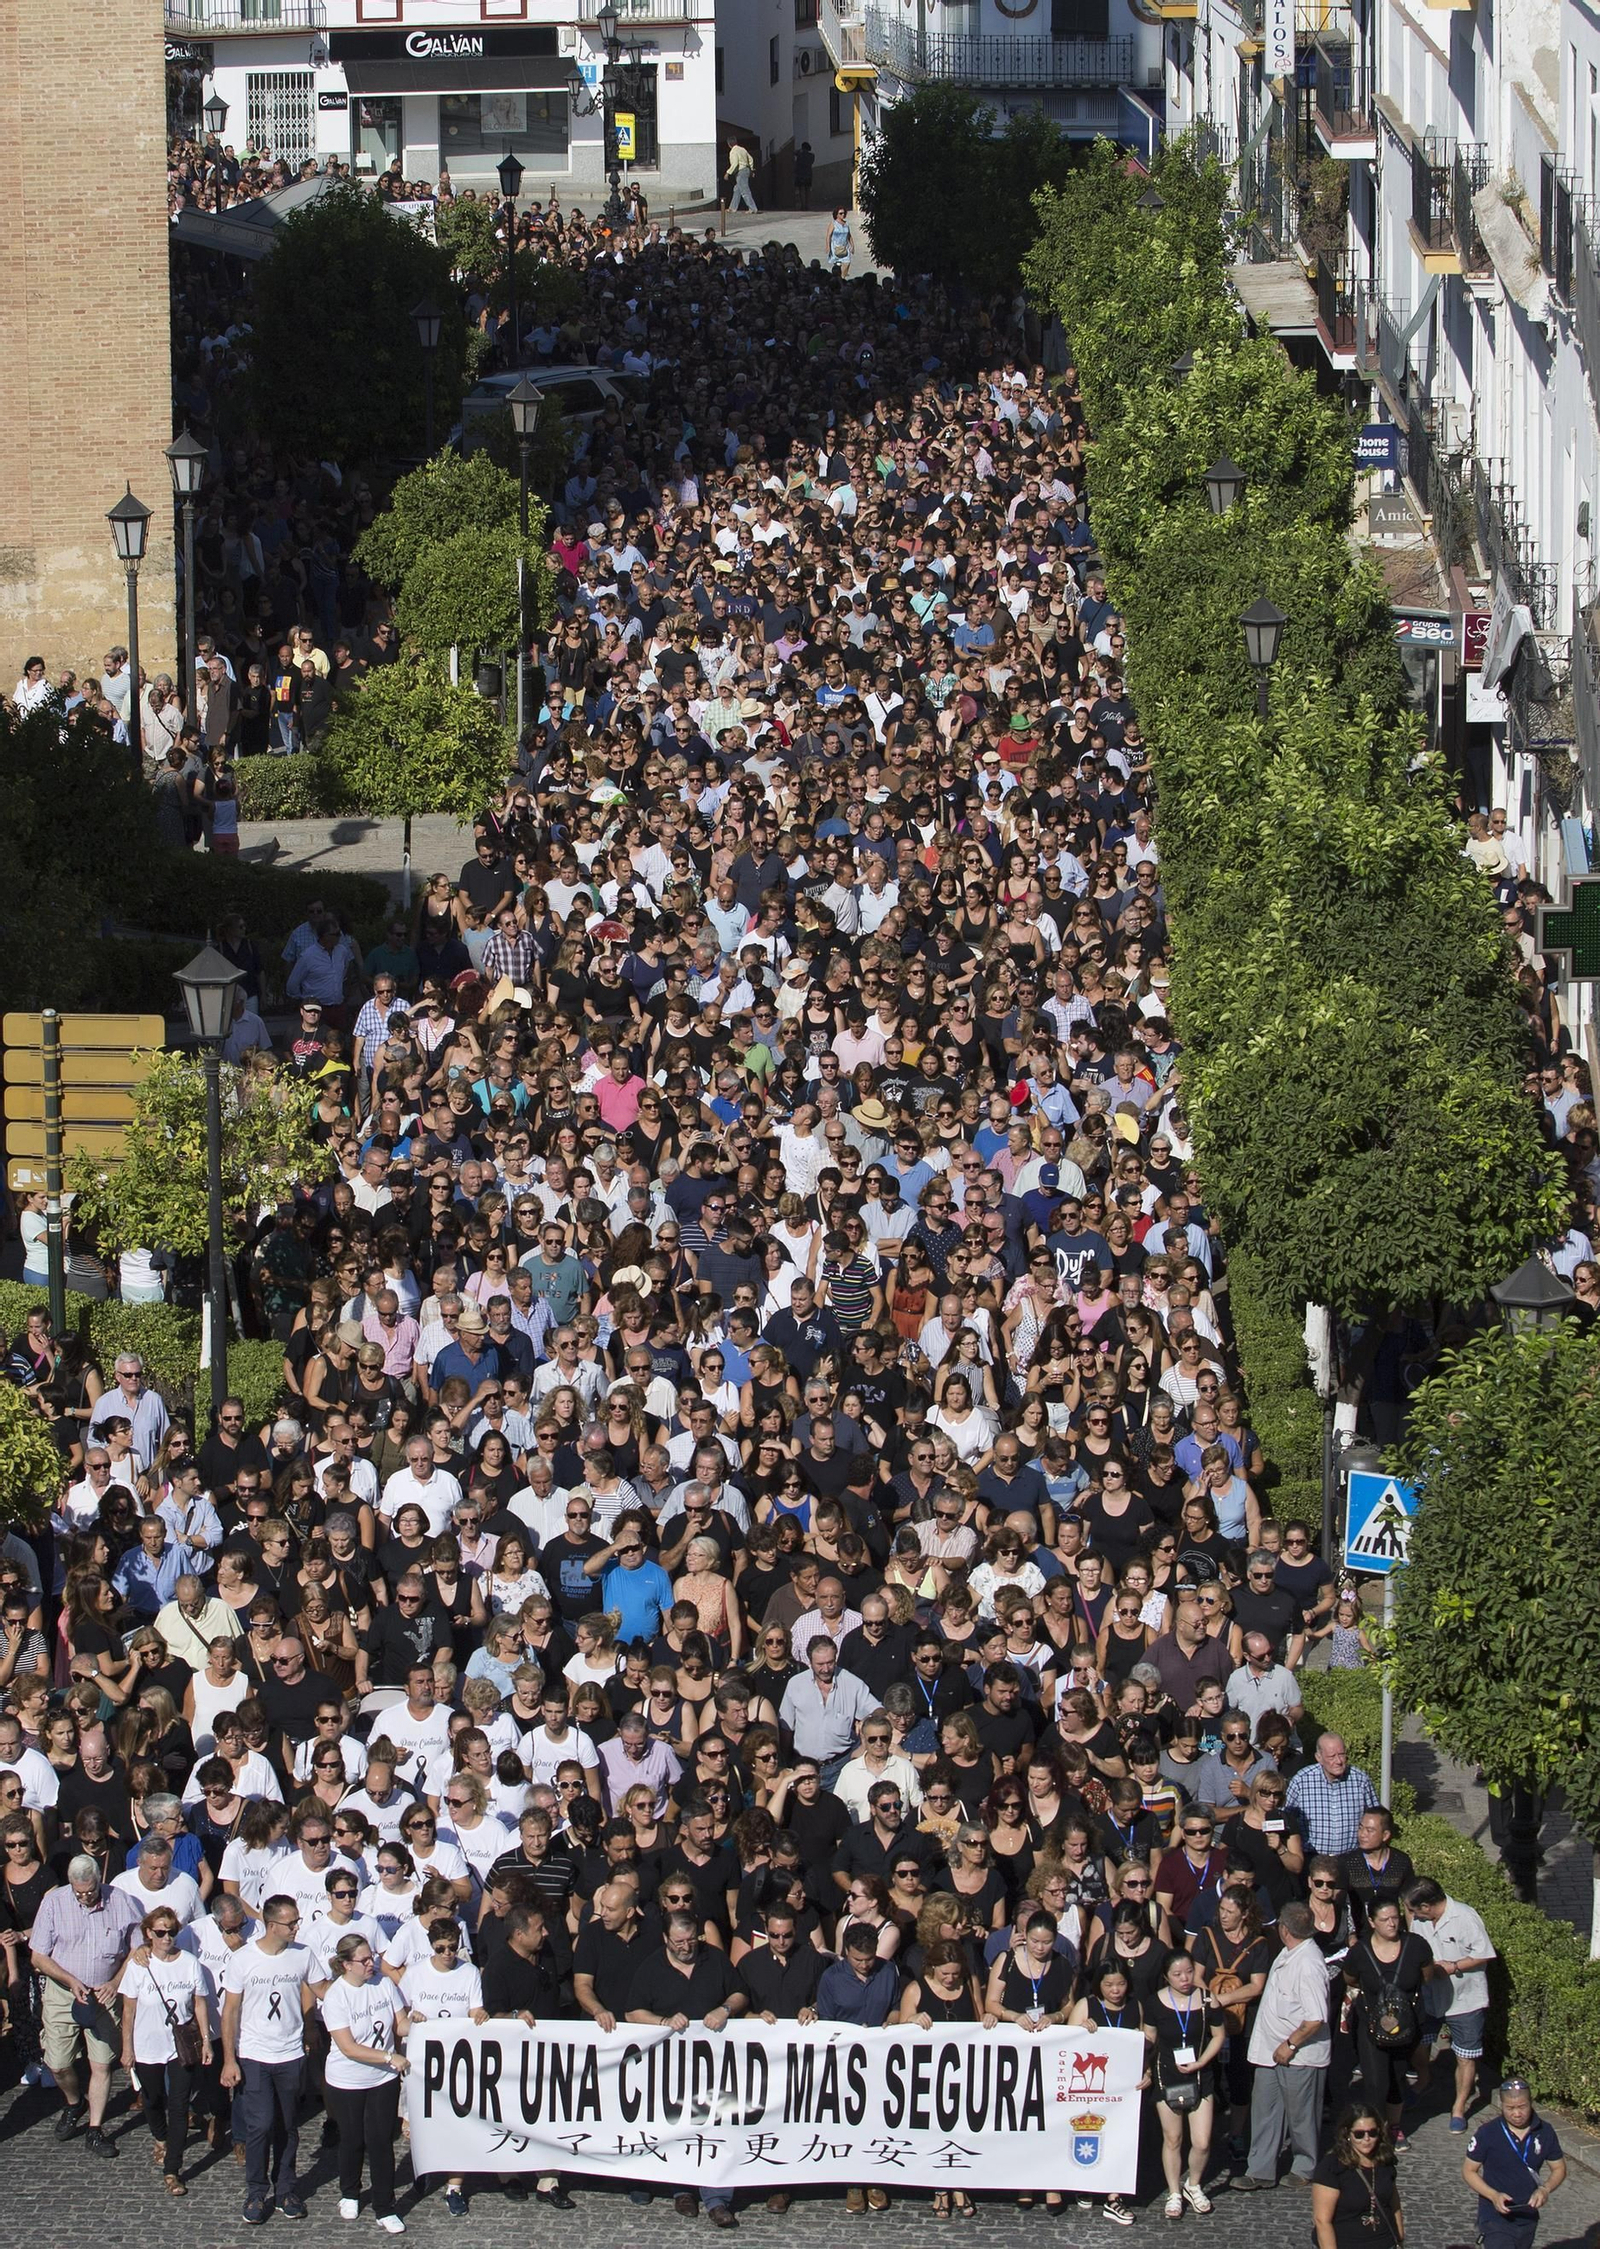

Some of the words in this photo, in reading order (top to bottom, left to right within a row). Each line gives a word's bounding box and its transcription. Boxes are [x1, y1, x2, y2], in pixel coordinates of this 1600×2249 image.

[1353, 437, 1390, 447] hone
[1375, 508, 1417, 522] Amic
[1412, 620, 1441, 629] Grupo
[423, 2037, 503, 2124] POR
[519, 2040, 603, 2125] UNA
[618, 2038, 769, 2127] CIUDAD
[782, 2032, 868, 2127] MÁS
[882, 2042, 1046, 2134] SEGURA
[486, 2127, 983, 2170] 为了城市更加安全
